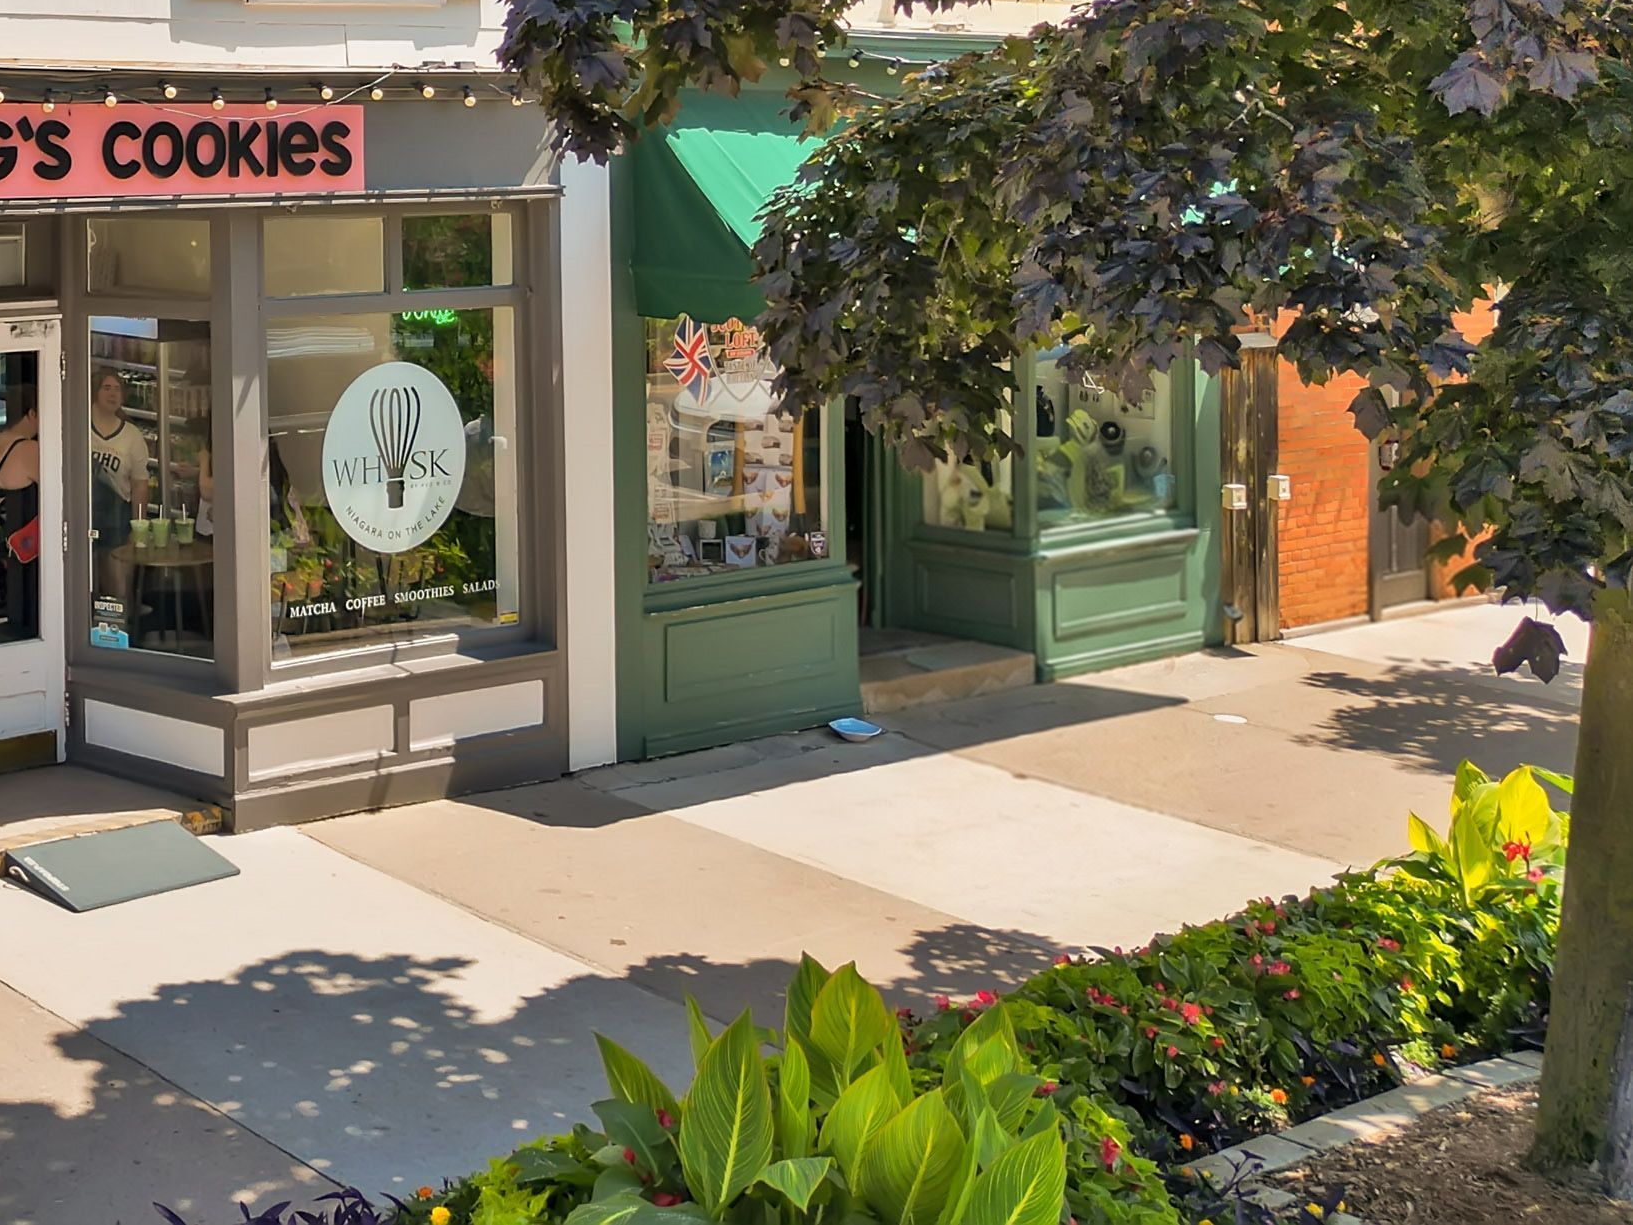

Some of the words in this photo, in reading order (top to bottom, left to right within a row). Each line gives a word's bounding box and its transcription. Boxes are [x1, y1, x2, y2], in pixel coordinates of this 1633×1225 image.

[724, 331, 759, 349] LOFT
[346, 506, 383, 539] NIAGARA
[388, 530, 401, 540] ON
[405, 520, 424, 536] THE
[424, 495, 446, 523] LAKE
[290, 601, 337, 619] MATCHA
[345, 594, 386, 611] COFFEE
[394, 585, 455, 604] SMOOTHIES
[462, 579, 500, 594] SALADS
